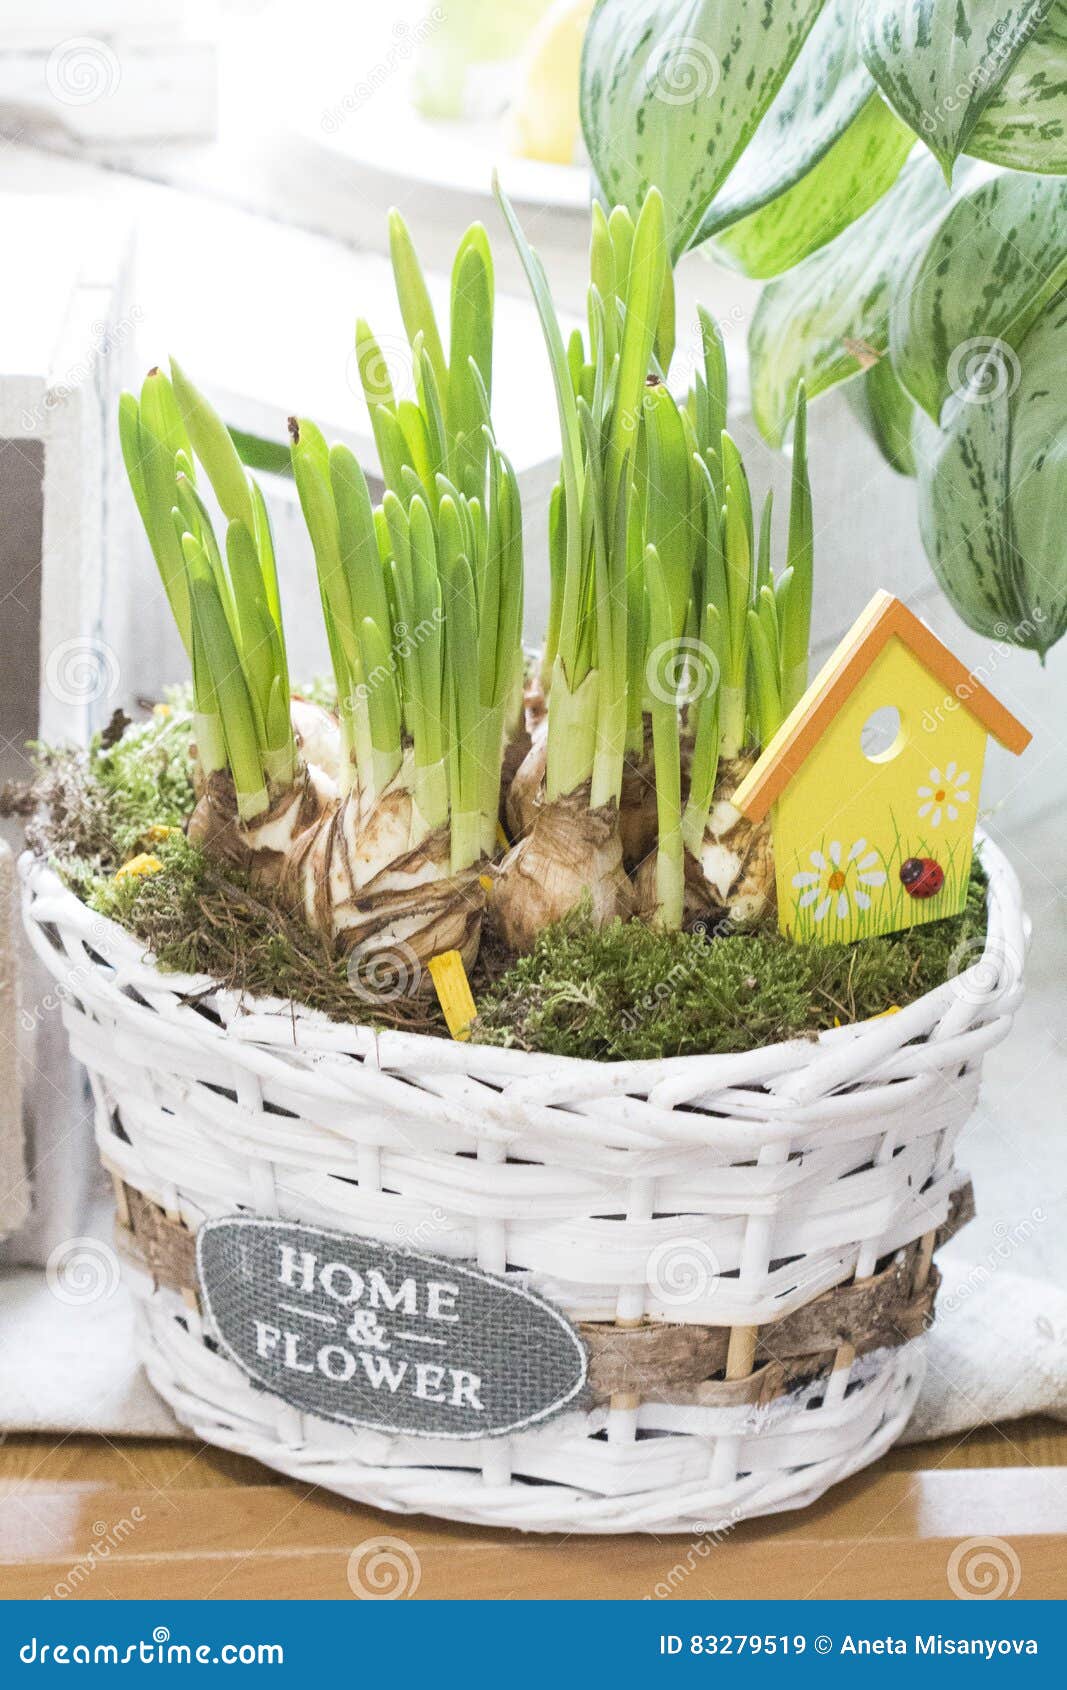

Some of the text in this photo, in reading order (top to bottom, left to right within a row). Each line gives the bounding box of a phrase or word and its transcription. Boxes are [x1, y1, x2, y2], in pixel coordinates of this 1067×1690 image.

[278, 1244, 460, 1322] HOME
[253, 1321, 485, 1410] FLOWER
[346, 1310, 391, 1350] &
